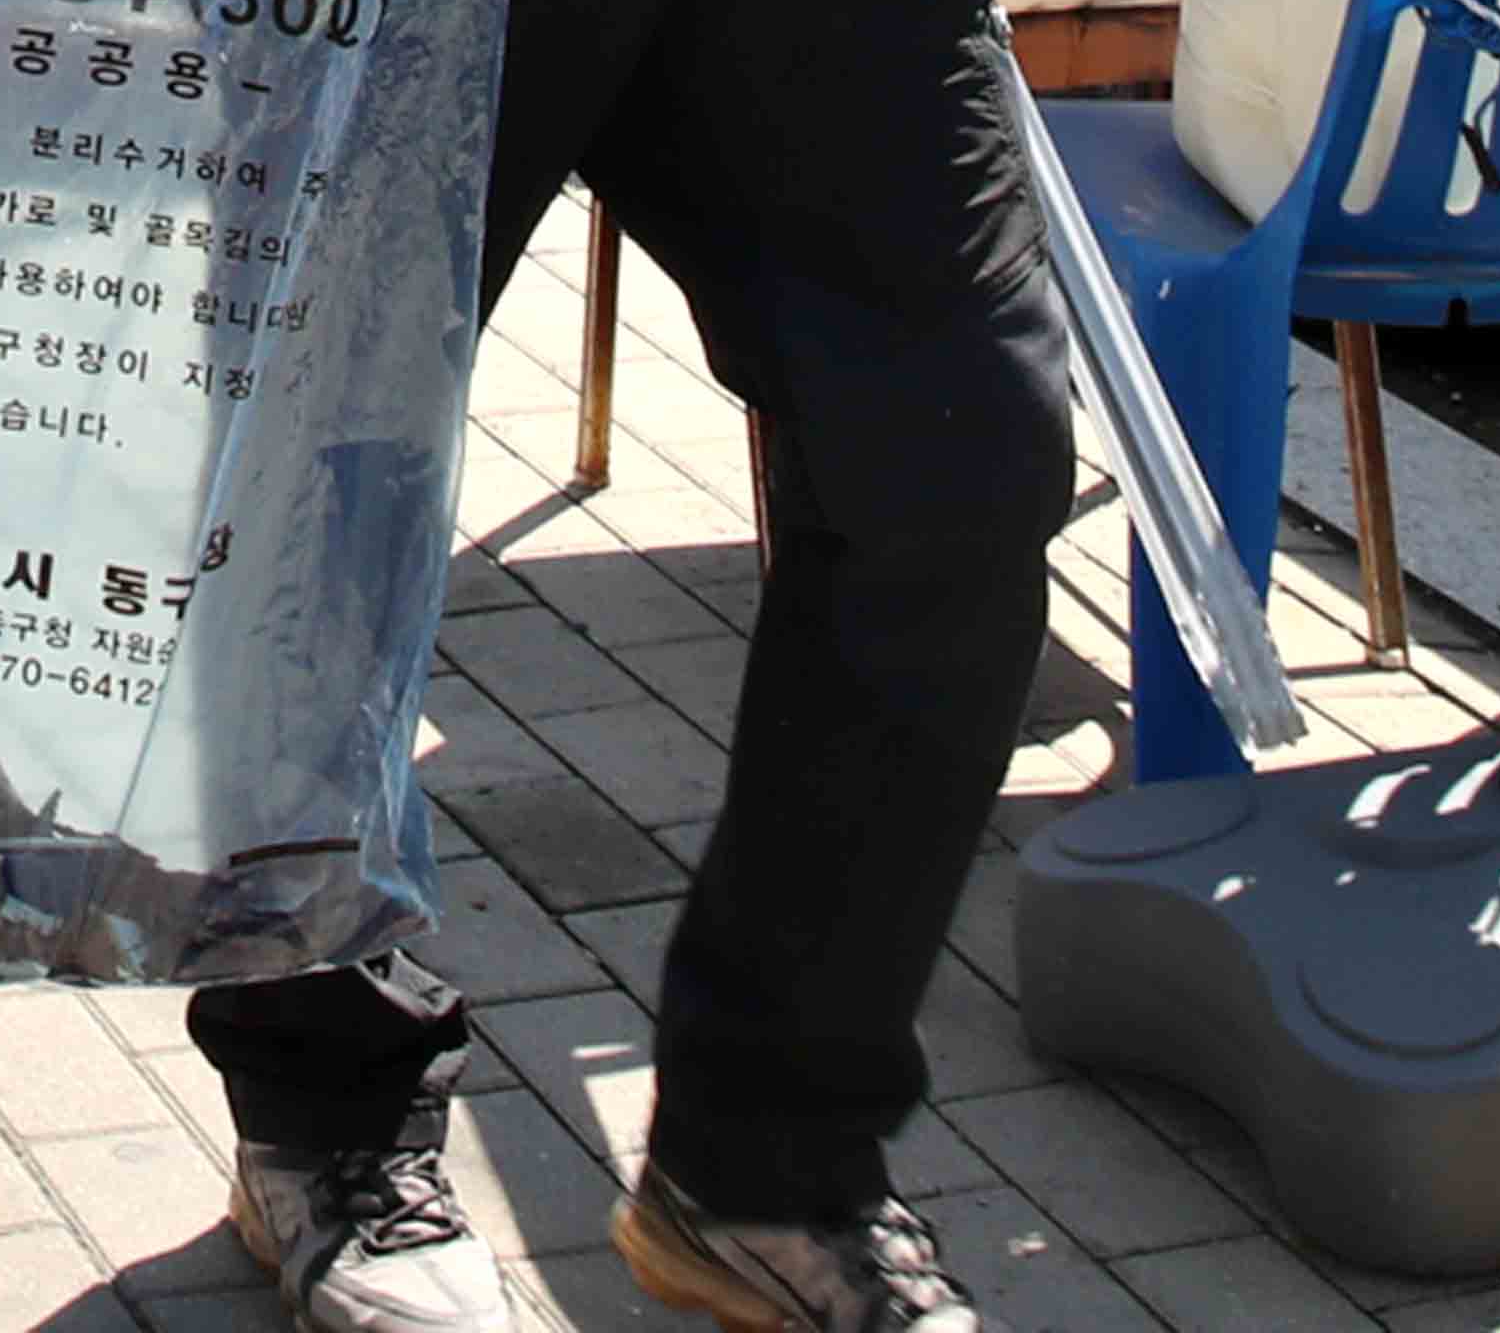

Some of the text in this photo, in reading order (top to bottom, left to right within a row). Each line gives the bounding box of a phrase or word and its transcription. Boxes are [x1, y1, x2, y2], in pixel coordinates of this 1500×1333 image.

[30, 125, 268, 194] 분리수거하여
[86, 202, 118, 239] 및
[144, 212, 292, 267] 골목길의
